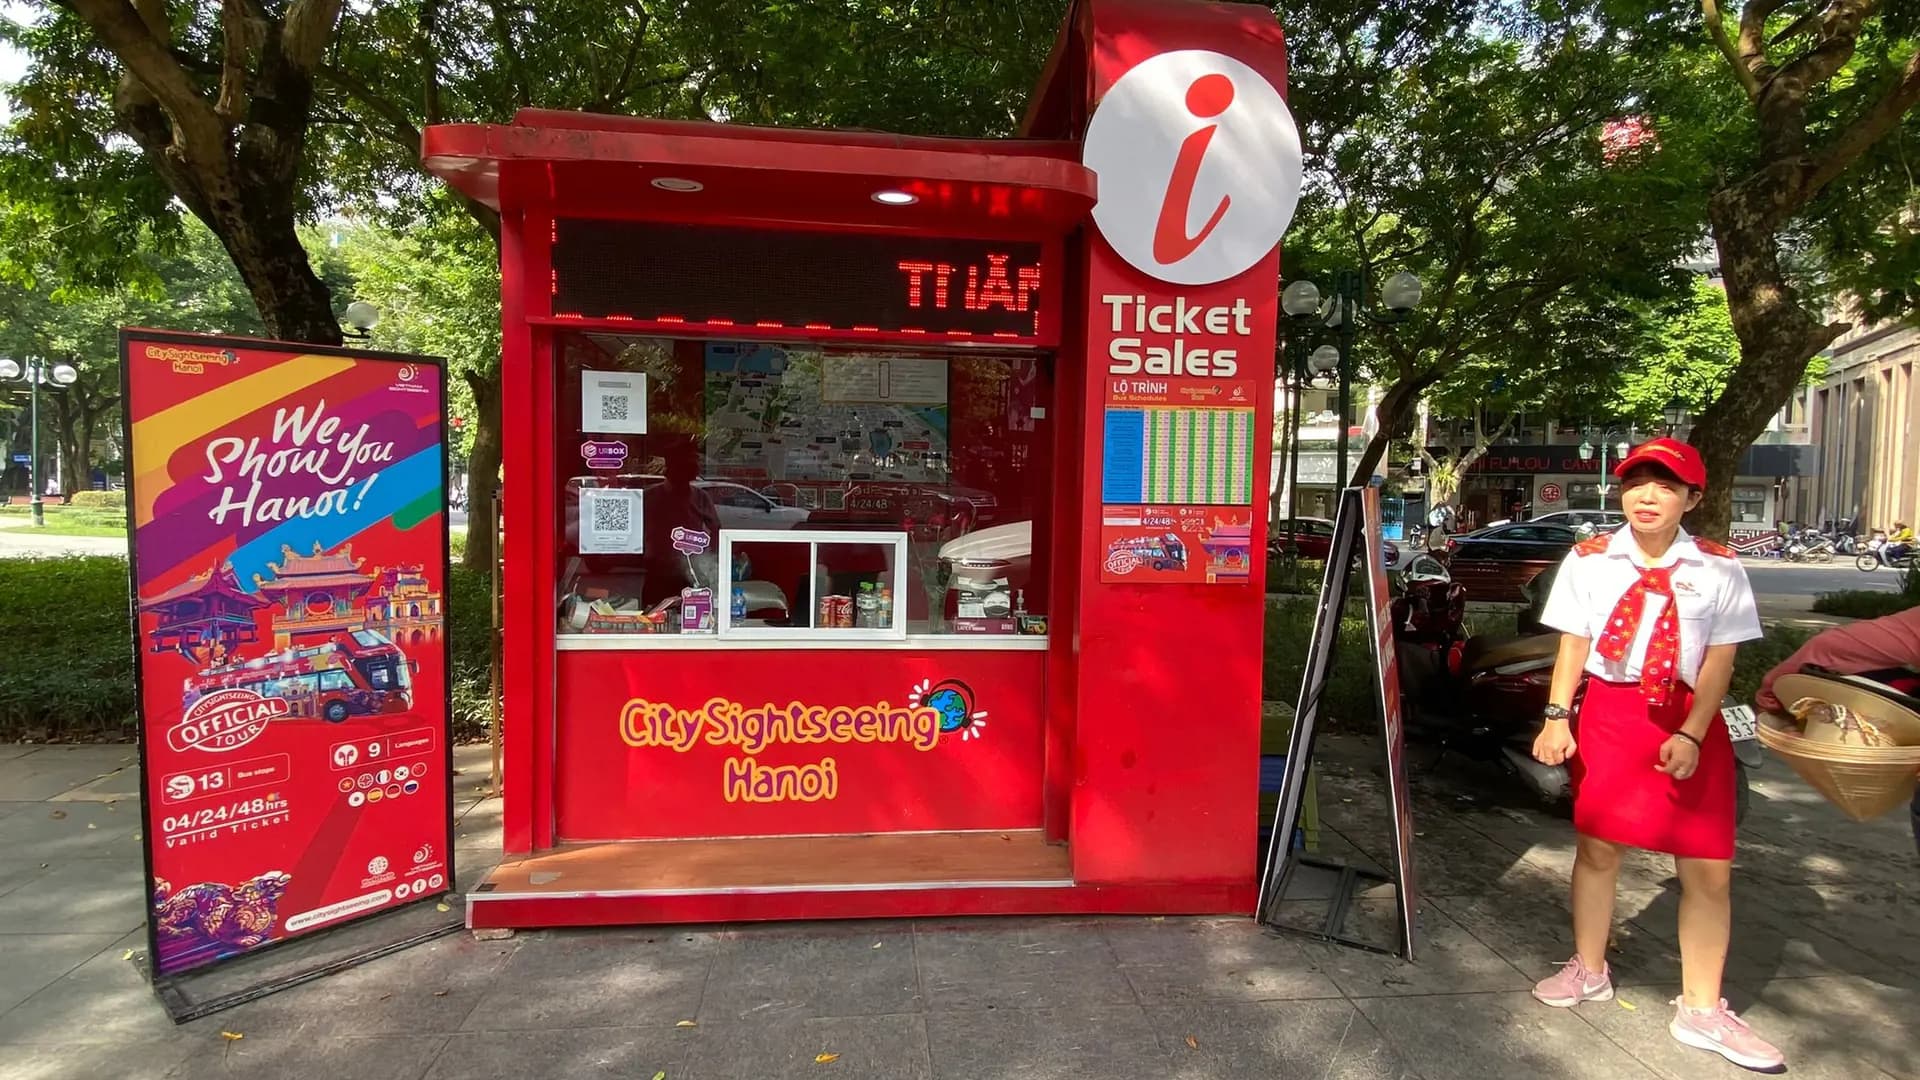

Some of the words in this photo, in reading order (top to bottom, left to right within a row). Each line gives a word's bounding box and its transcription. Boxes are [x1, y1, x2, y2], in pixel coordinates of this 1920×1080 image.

[1153, 73, 1235, 265] i
[1102, 295, 1251, 335] Ticket
[173, 361, 204, 374] Hanoi
[1109, 338, 1237, 377] Sales
[1113, 379, 1128, 395] LỘ
[1132, 380, 1168, 394] TRÌNH
[272, 398, 340, 445] We
[203, 432, 331, 485] Show
[318, 424, 393, 485] You
[208, 473, 379, 527] Hanoi!
[181, 701, 283, 743] OFFICIAL
[216, 725, 260, 746] TOUR
[620, 697, 940, 754] CitySightseeing
[368, 742, 381, 758] 9
[198, 772, 224, 790] 13
[723, 757, 838, 802] Hanoi
[166, 829, 217, 848] Valid
[230, 814, 290, 833] Ticket
